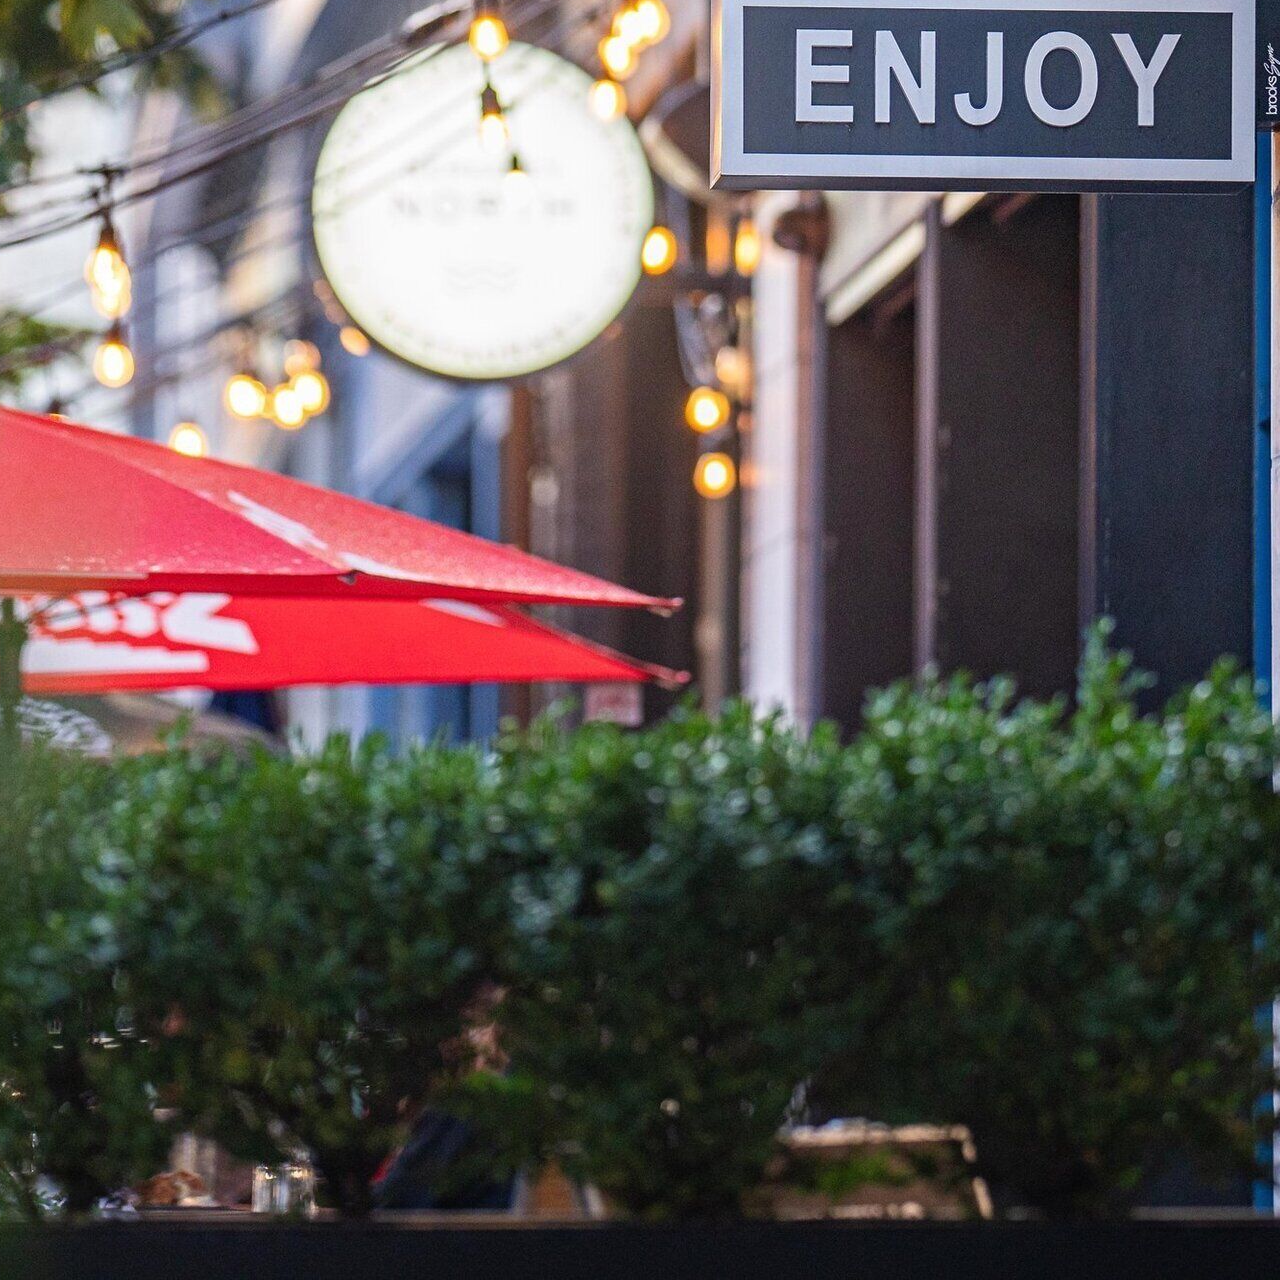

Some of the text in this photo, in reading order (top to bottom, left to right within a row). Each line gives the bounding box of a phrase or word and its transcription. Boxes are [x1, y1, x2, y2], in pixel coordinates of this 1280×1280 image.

[795, 28, 1182, 127] ENJOY
[1265, 75, 1278, 115] brooks
[390, 191, 576, 221] NORH
